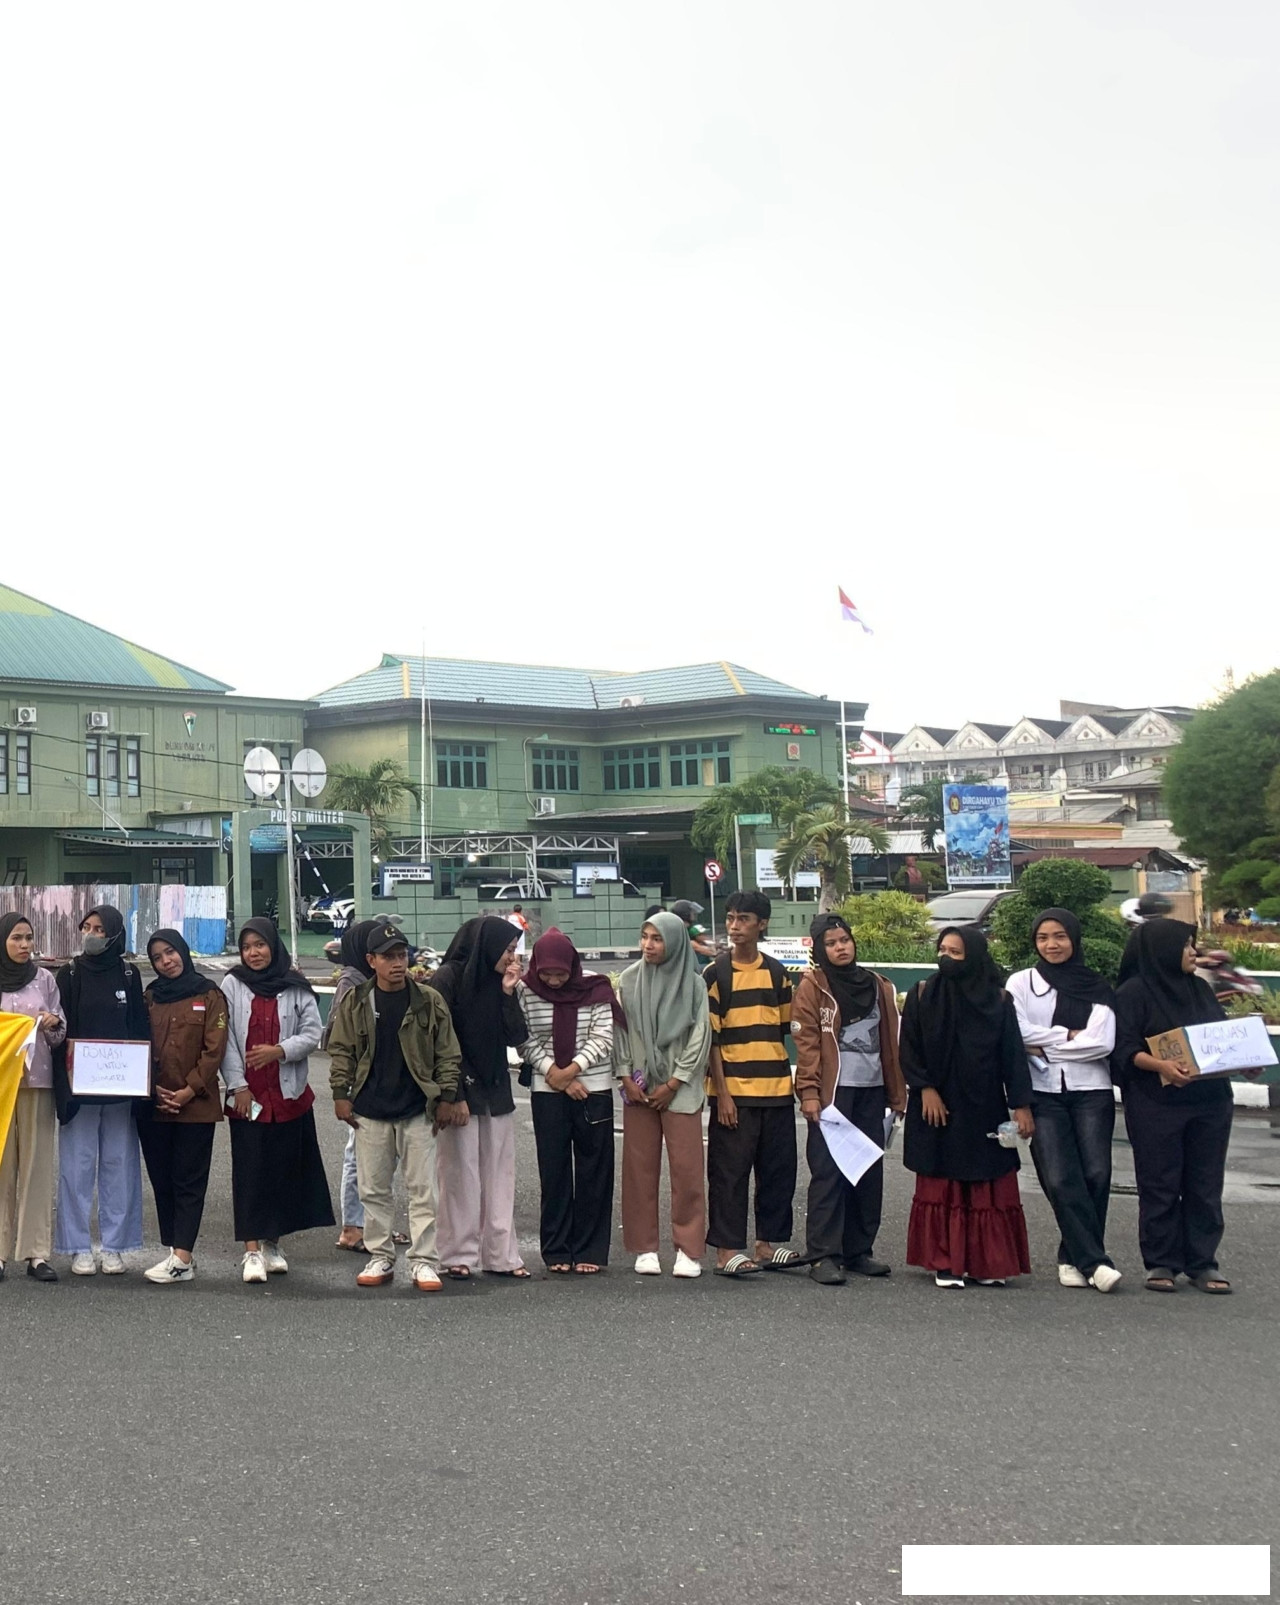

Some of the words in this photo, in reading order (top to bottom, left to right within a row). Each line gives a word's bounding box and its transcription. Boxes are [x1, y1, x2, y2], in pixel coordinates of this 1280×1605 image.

[962, 796, 995, 806] DIRGAHAYU
[271, 810, 301, 822] POLSI
[306, 811, 344, 824] MILITER
[1203, 1026, 1248, 1039] DONASI
[82, 1045, 123, 1060] DONASI
[96, 1061, 129, 1070] UNTUK
